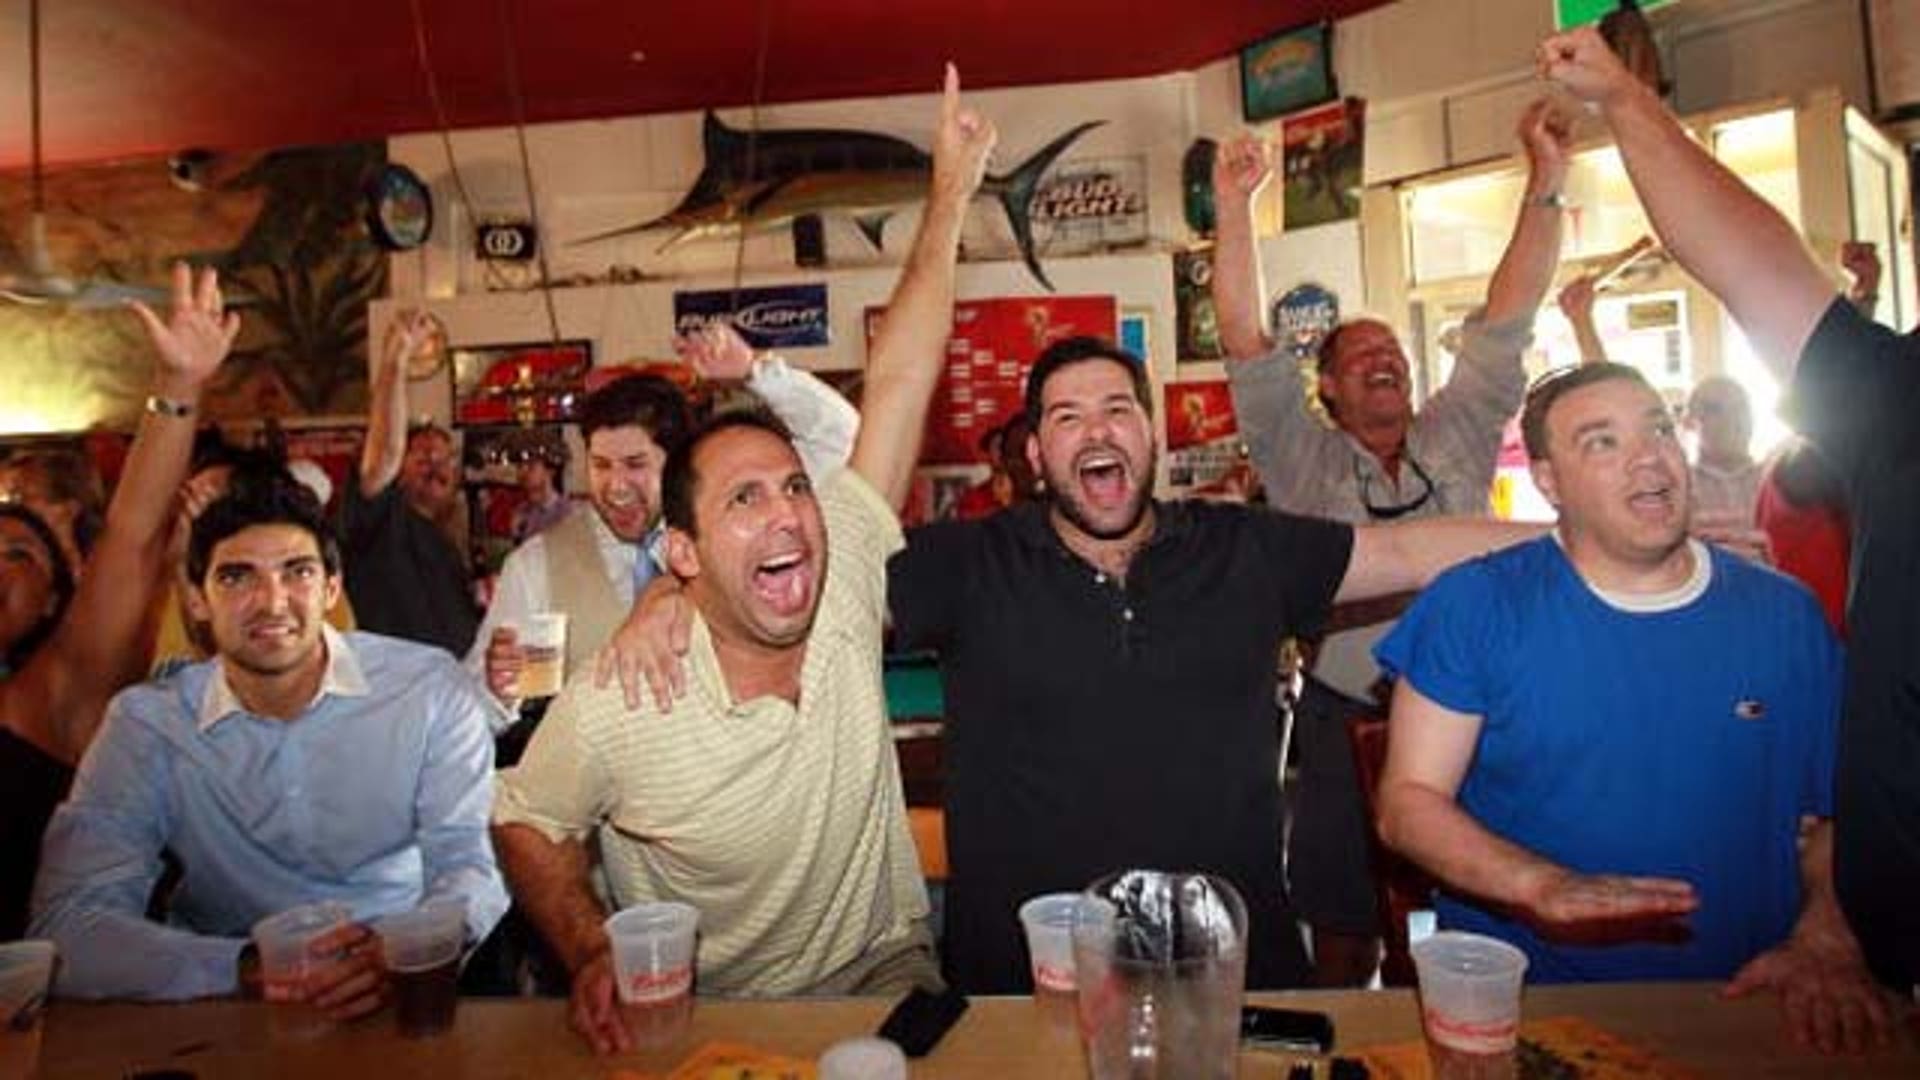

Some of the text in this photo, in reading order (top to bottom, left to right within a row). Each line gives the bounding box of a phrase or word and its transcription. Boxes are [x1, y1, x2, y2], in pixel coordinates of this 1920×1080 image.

[1046, 178, 1124, 200] BUD
[1032, 193, 1142, 216] LIGHT
[744, 306, 824, 329] LIGHT
